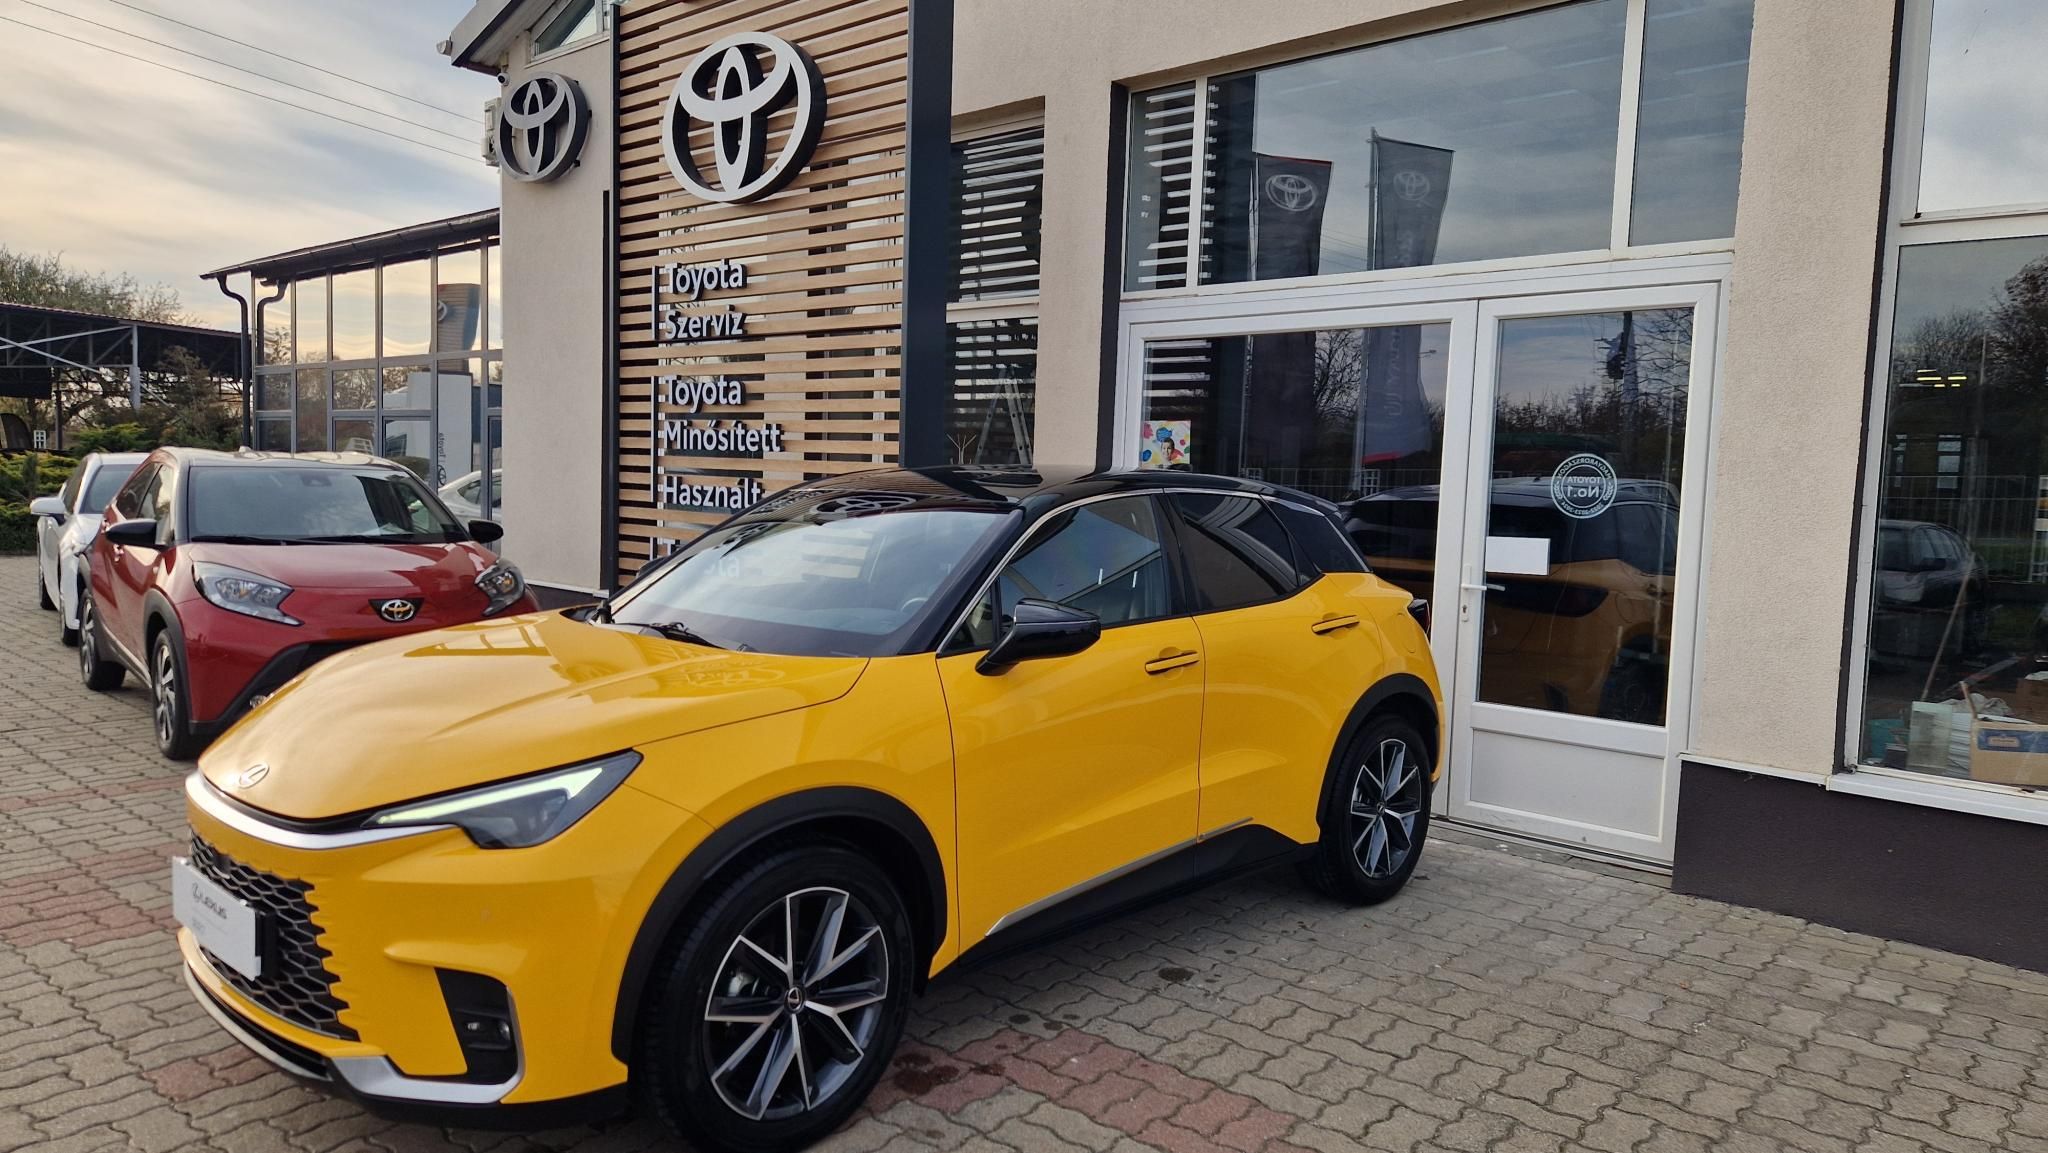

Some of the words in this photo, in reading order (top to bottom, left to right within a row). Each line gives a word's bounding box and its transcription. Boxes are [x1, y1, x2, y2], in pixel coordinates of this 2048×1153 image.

[664, 259, 743, 300] Toyota
[665, 304, 743, 339] Szerviz
[664, 374, 742, 413] Toyota
[663, 419, 781, 452] Minősített
[663, 476, 760, 509] Használt
